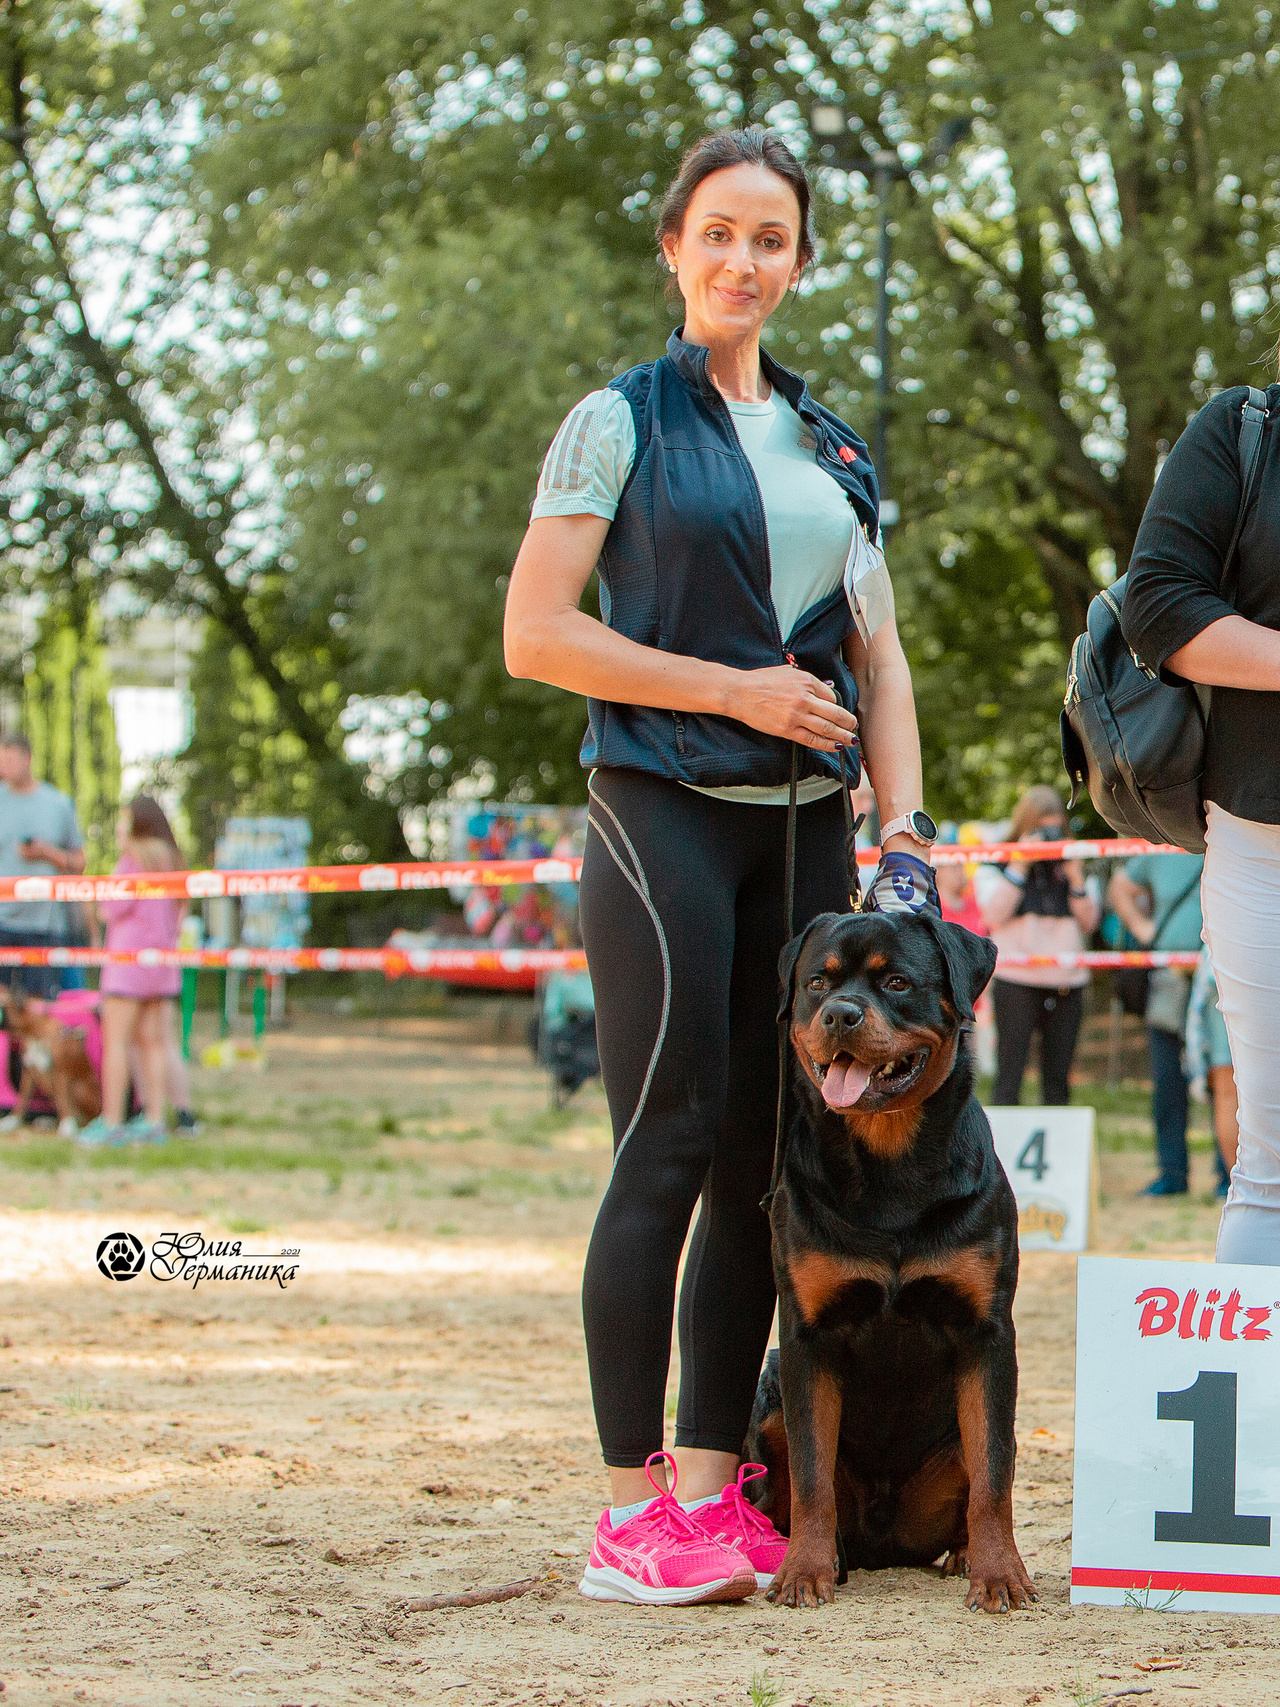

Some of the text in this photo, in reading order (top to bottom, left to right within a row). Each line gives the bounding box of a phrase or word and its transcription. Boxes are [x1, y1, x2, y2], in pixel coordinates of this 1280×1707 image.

[1016, 1129, 1049, 1180] 4
[1135, 1287, 1273, 1342] Blitz
[1154, 1371, 1271, 1547] 1
